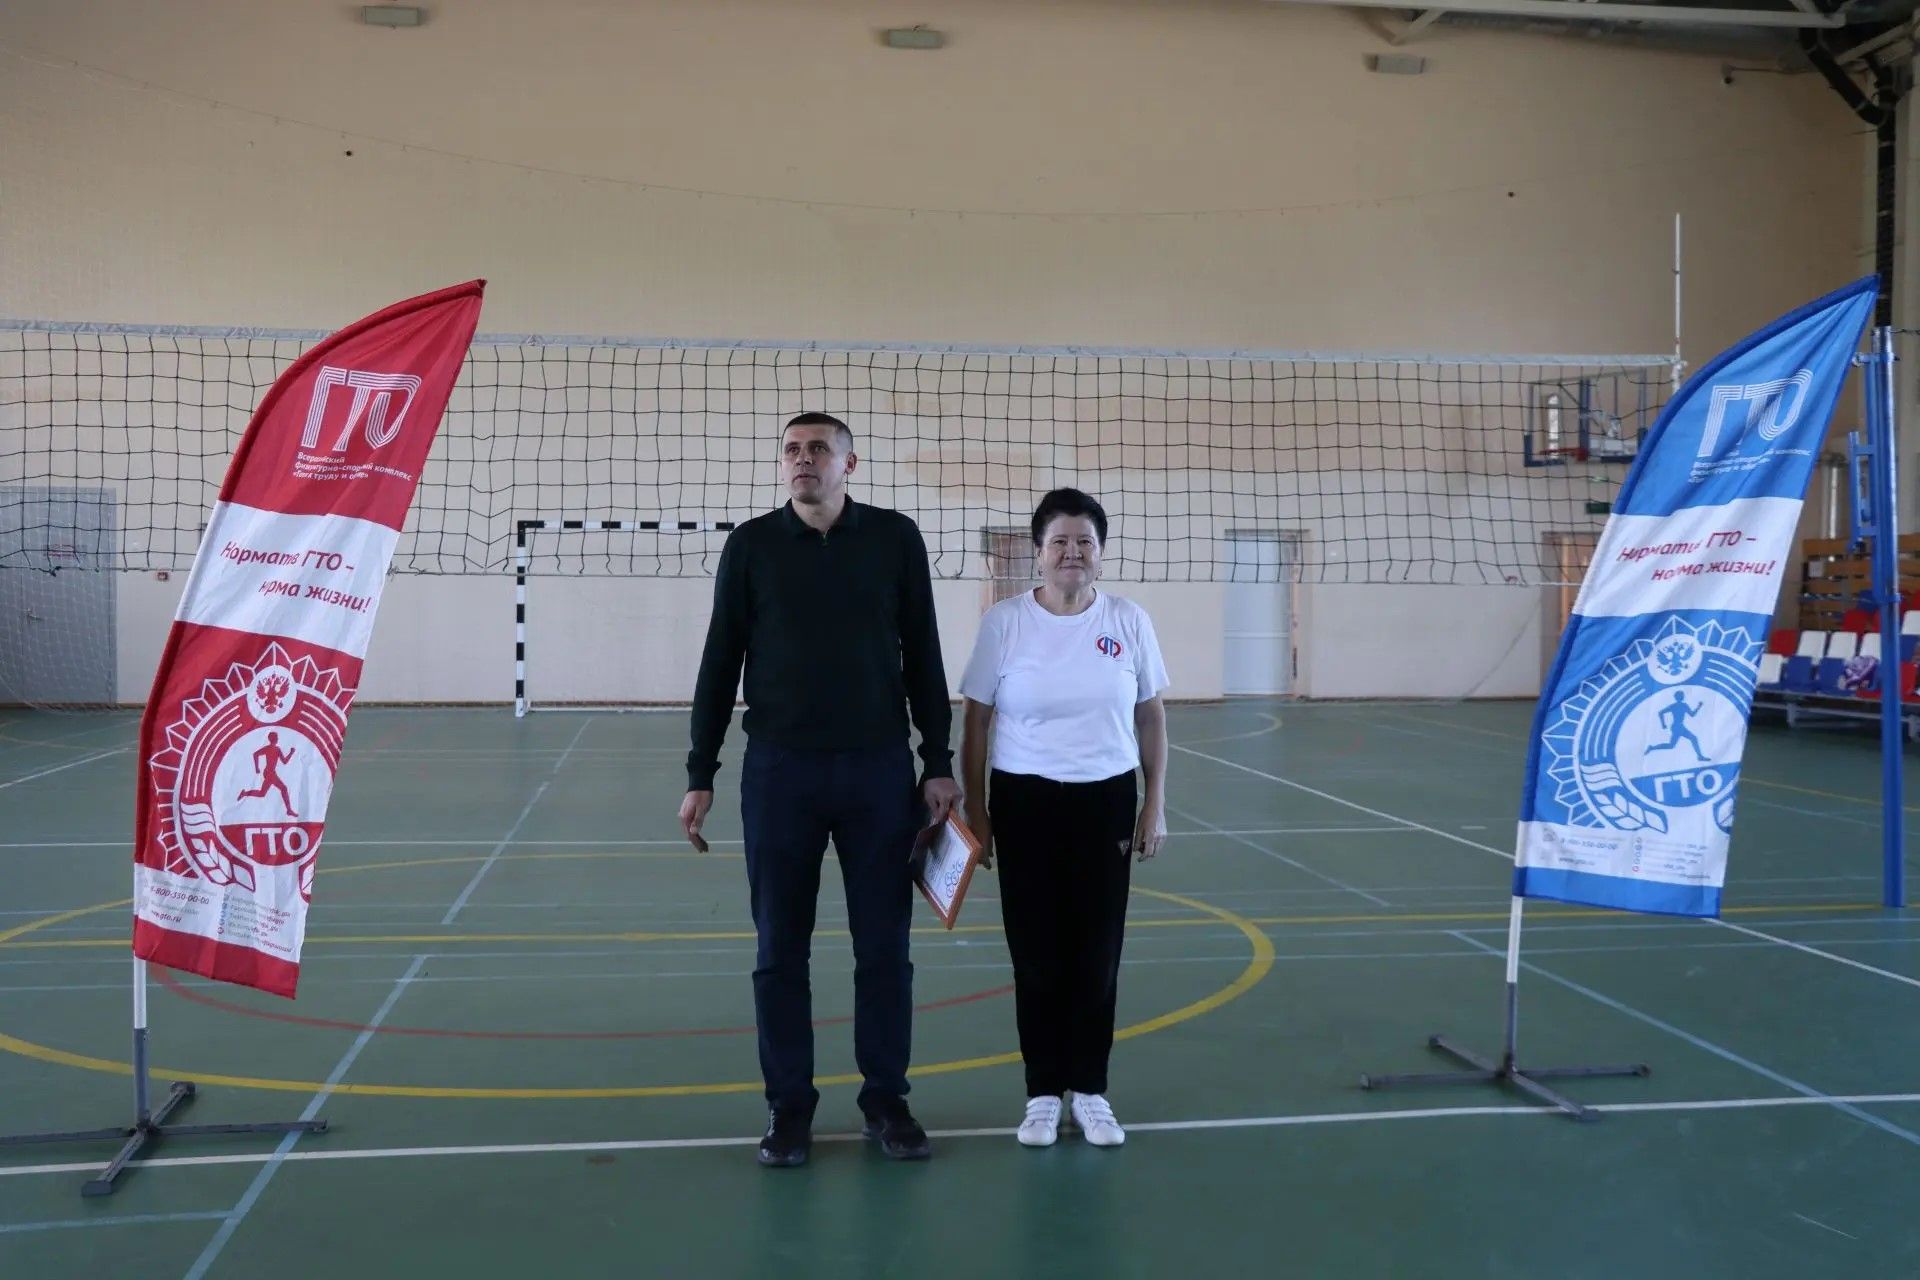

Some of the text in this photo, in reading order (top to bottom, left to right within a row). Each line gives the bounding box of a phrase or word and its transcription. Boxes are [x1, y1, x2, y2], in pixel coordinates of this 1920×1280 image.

[301, 365, 422, 451] ГТО
[1697, 369, 1813, 457] ГТО
[314, 473, 339, 481] труду
[1705, 530, 1742, 549] ГТО
[220, 541, 300, 565] Норматв
[301, 549, 343, 571] ГТО
[1651, 560, 1776, 581] нома жизни!
[258, 580, 371, 613] нрма жизни!
[1653, 769, 1723, 802] ГТО
[245, 826, 310, 857] ГТО
